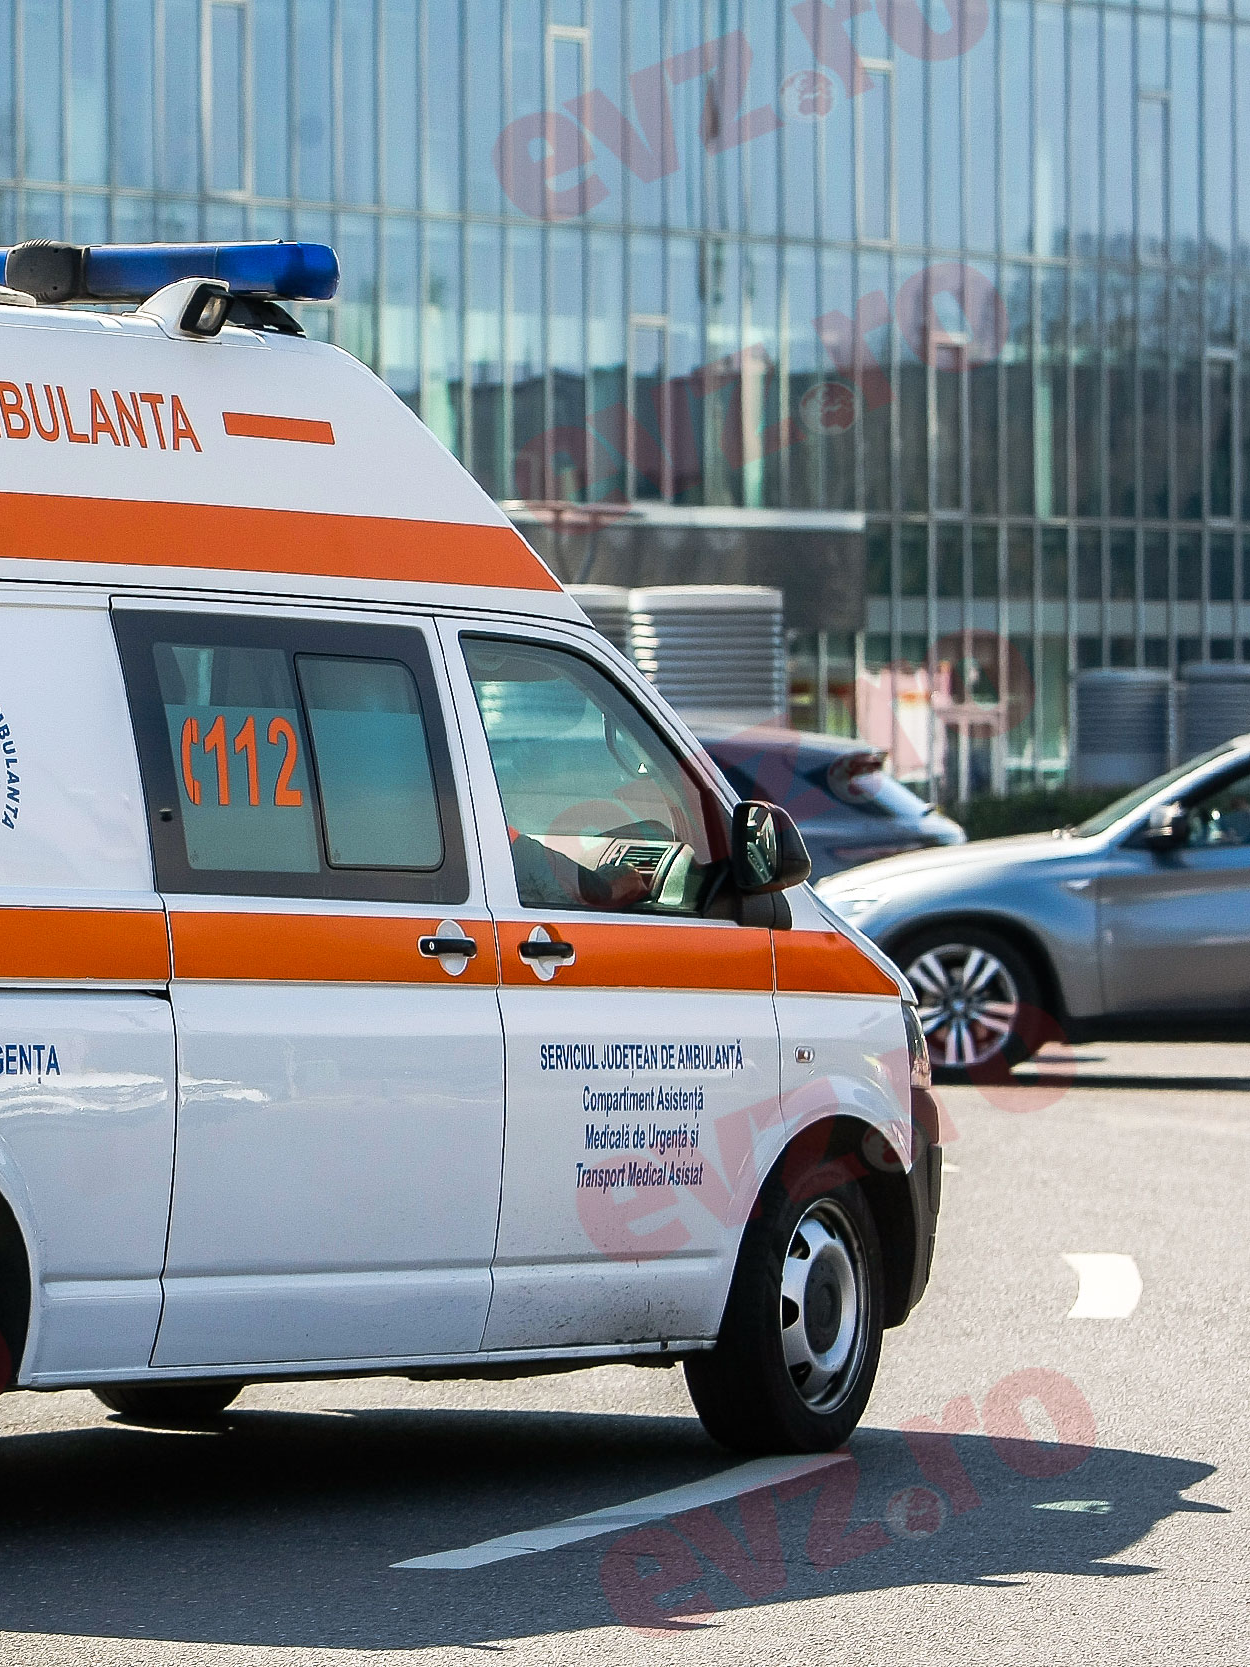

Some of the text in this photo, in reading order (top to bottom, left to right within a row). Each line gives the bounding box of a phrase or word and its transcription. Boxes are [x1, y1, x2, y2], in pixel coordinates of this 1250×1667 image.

[203, 714, 303, 806] 112
[540, 1044, 599, 1071] SERVICIUL
[601, 1044, 658, 1078] JUDEȚEAN
[661, 1044, 675, 1070] DE
[582, 1085, 655, 1117] Compartiment
[584, 1123, 630, 1150] Medicală
[632, 1123, 646, 1149] de
[576, 1160, 704, 1194] Transport Medical Asistat
